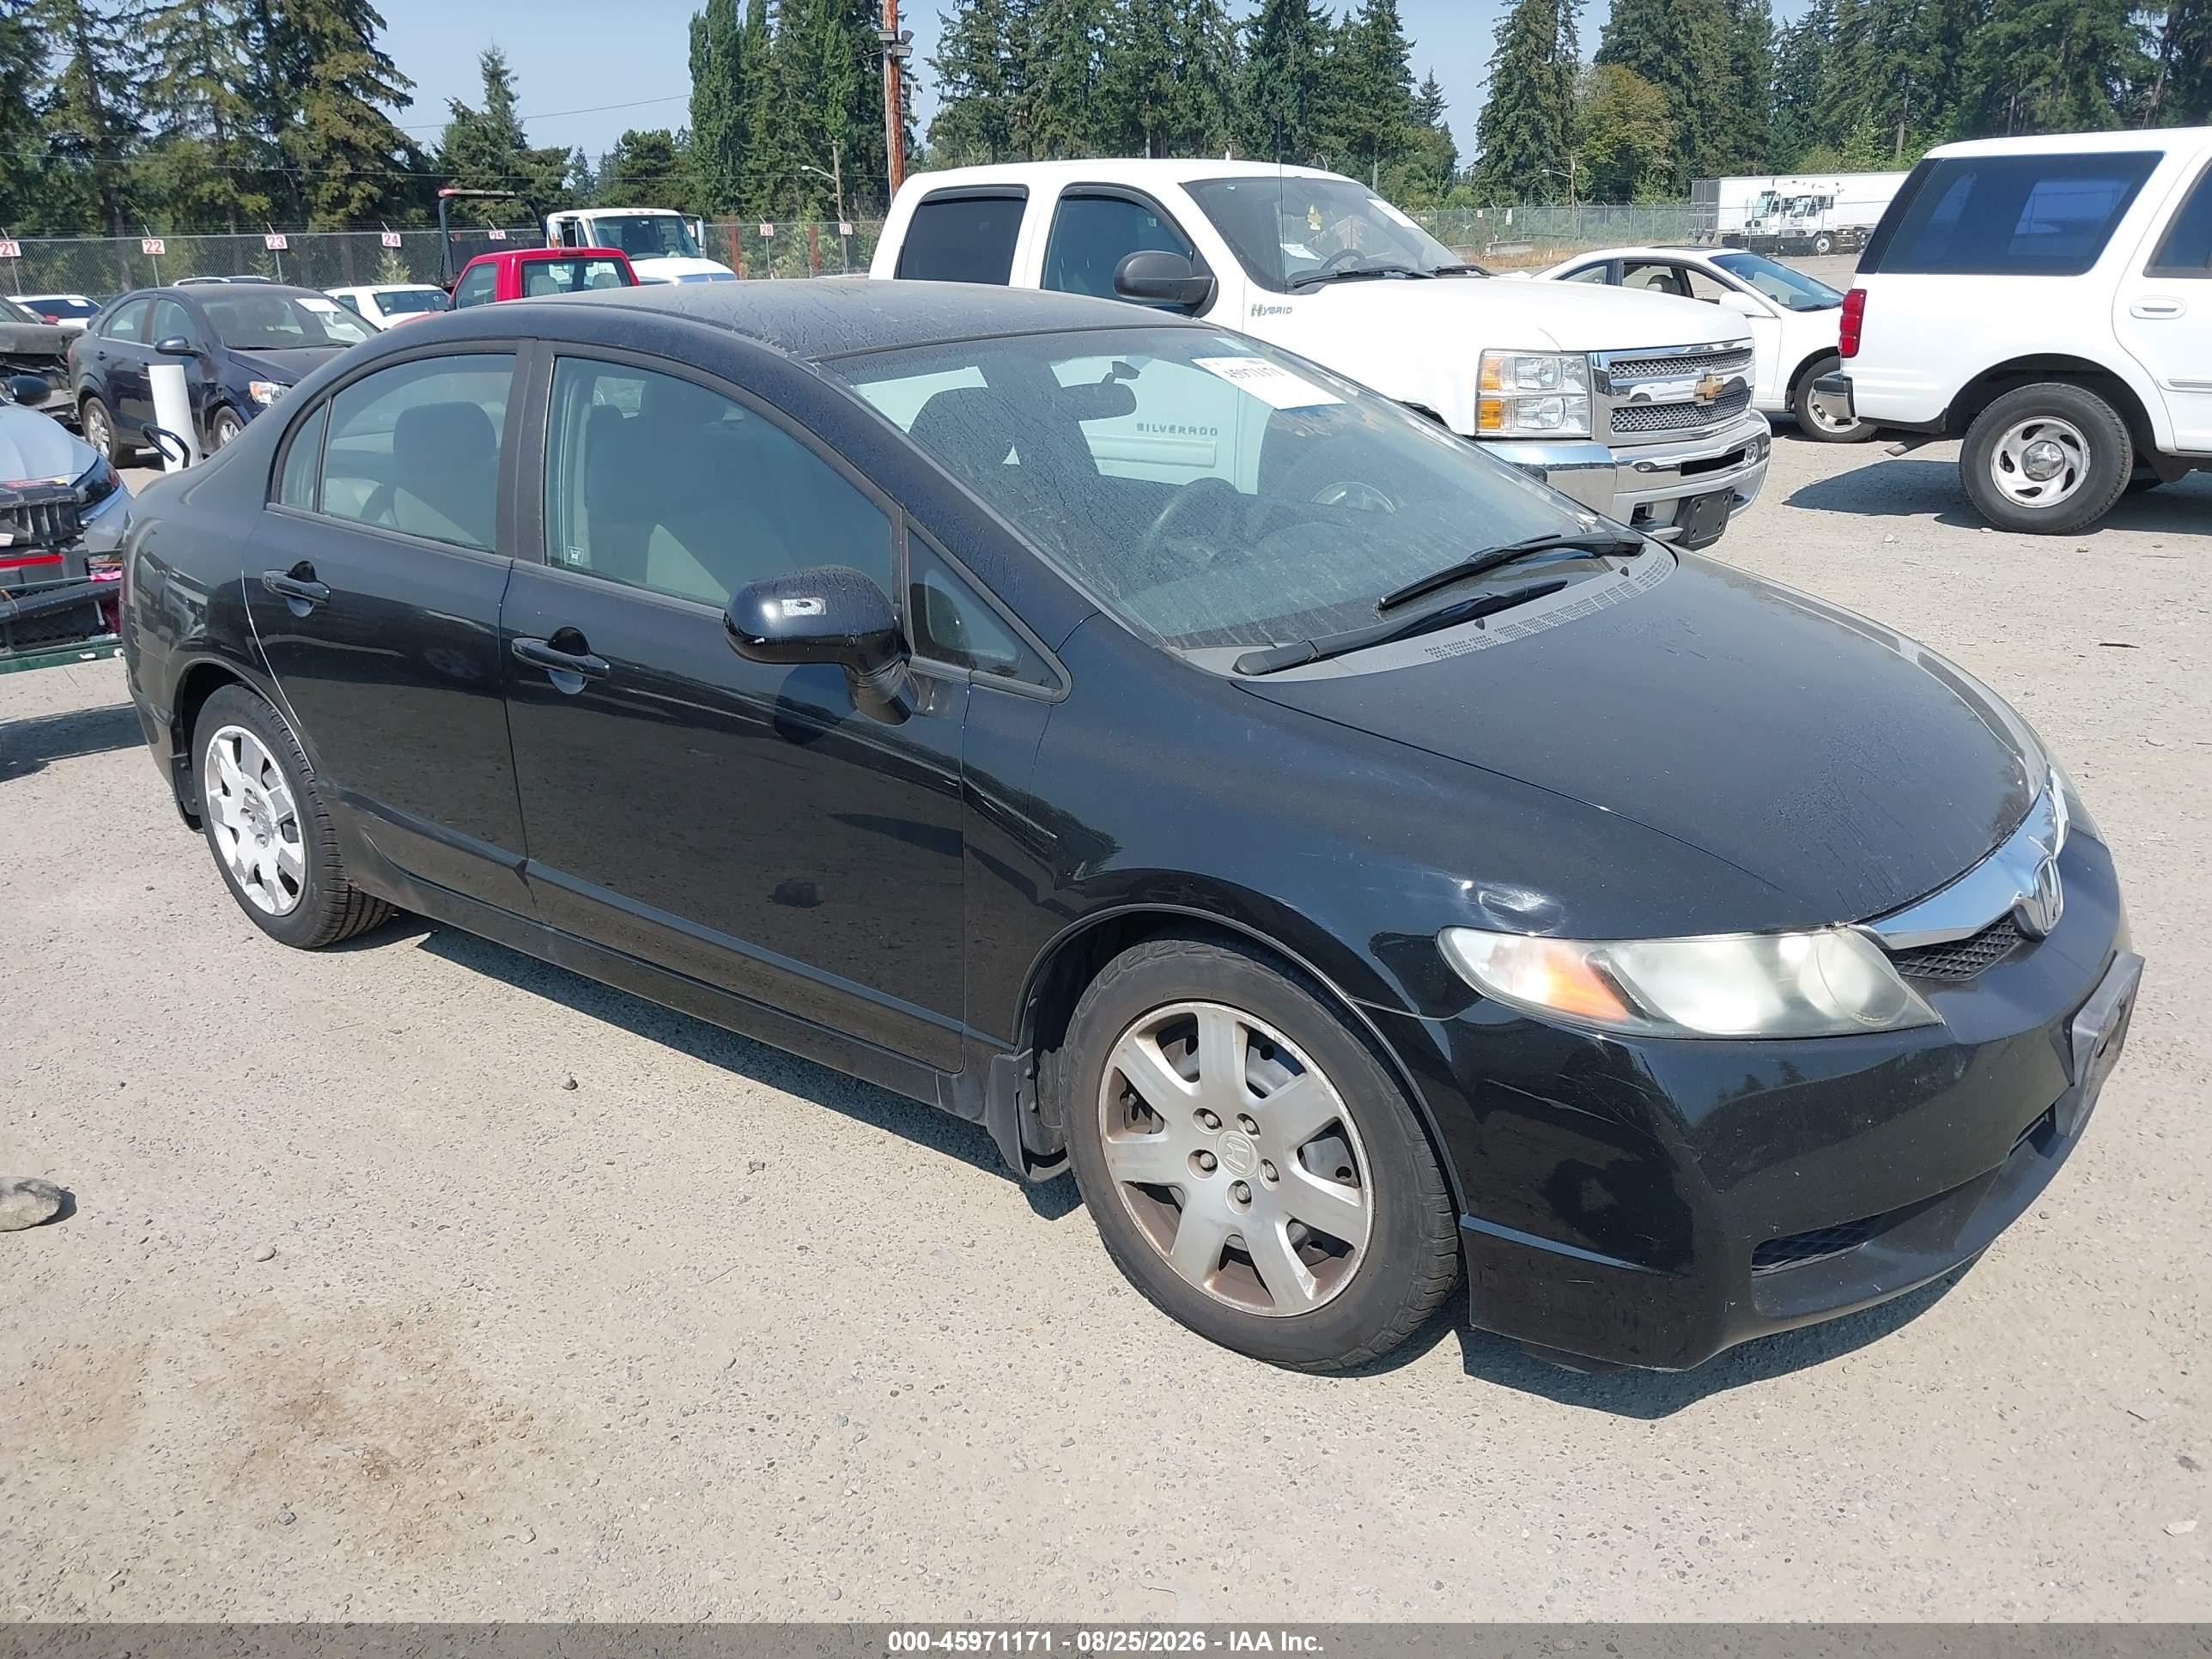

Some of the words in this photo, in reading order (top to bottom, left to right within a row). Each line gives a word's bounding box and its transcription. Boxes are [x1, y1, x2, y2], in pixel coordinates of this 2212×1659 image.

[761, 225, 772, 235] 28
[268, 236, 284, 248] 23
[384, 234, 399, 246] 24
[0, 242, 17, 256] 21
[144, 240, 163, 253] 22
[1136, 422, 1218, 436] SILVERADO
